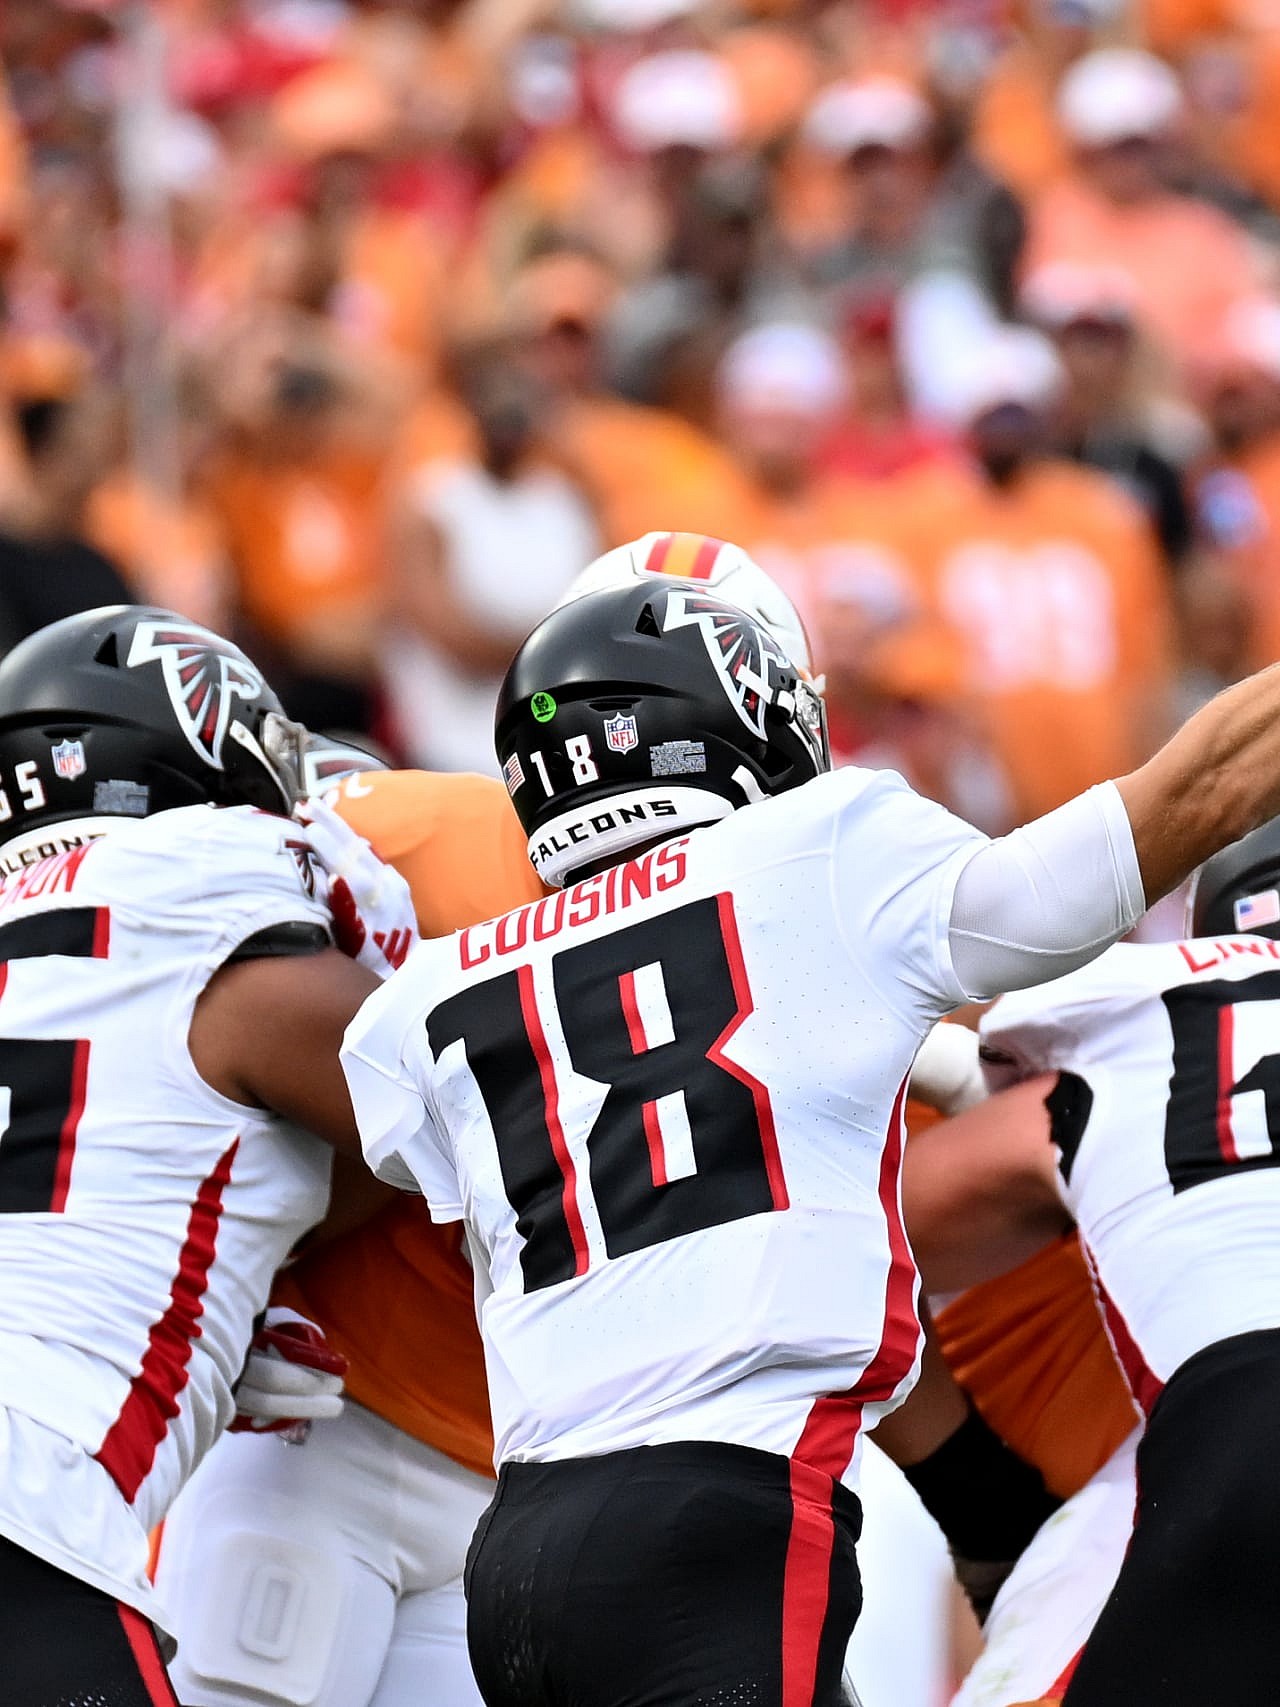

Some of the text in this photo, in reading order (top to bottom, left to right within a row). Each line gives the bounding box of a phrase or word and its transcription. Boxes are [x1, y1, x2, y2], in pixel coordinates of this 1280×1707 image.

[529, 734, 599, 797] 18
[611, 730, 634, 746] NFL
[529, 799, 677, 870] FALCONS
[459, 838, 690, 971] COUSINS
[426, 891, 789, 1294] 18
